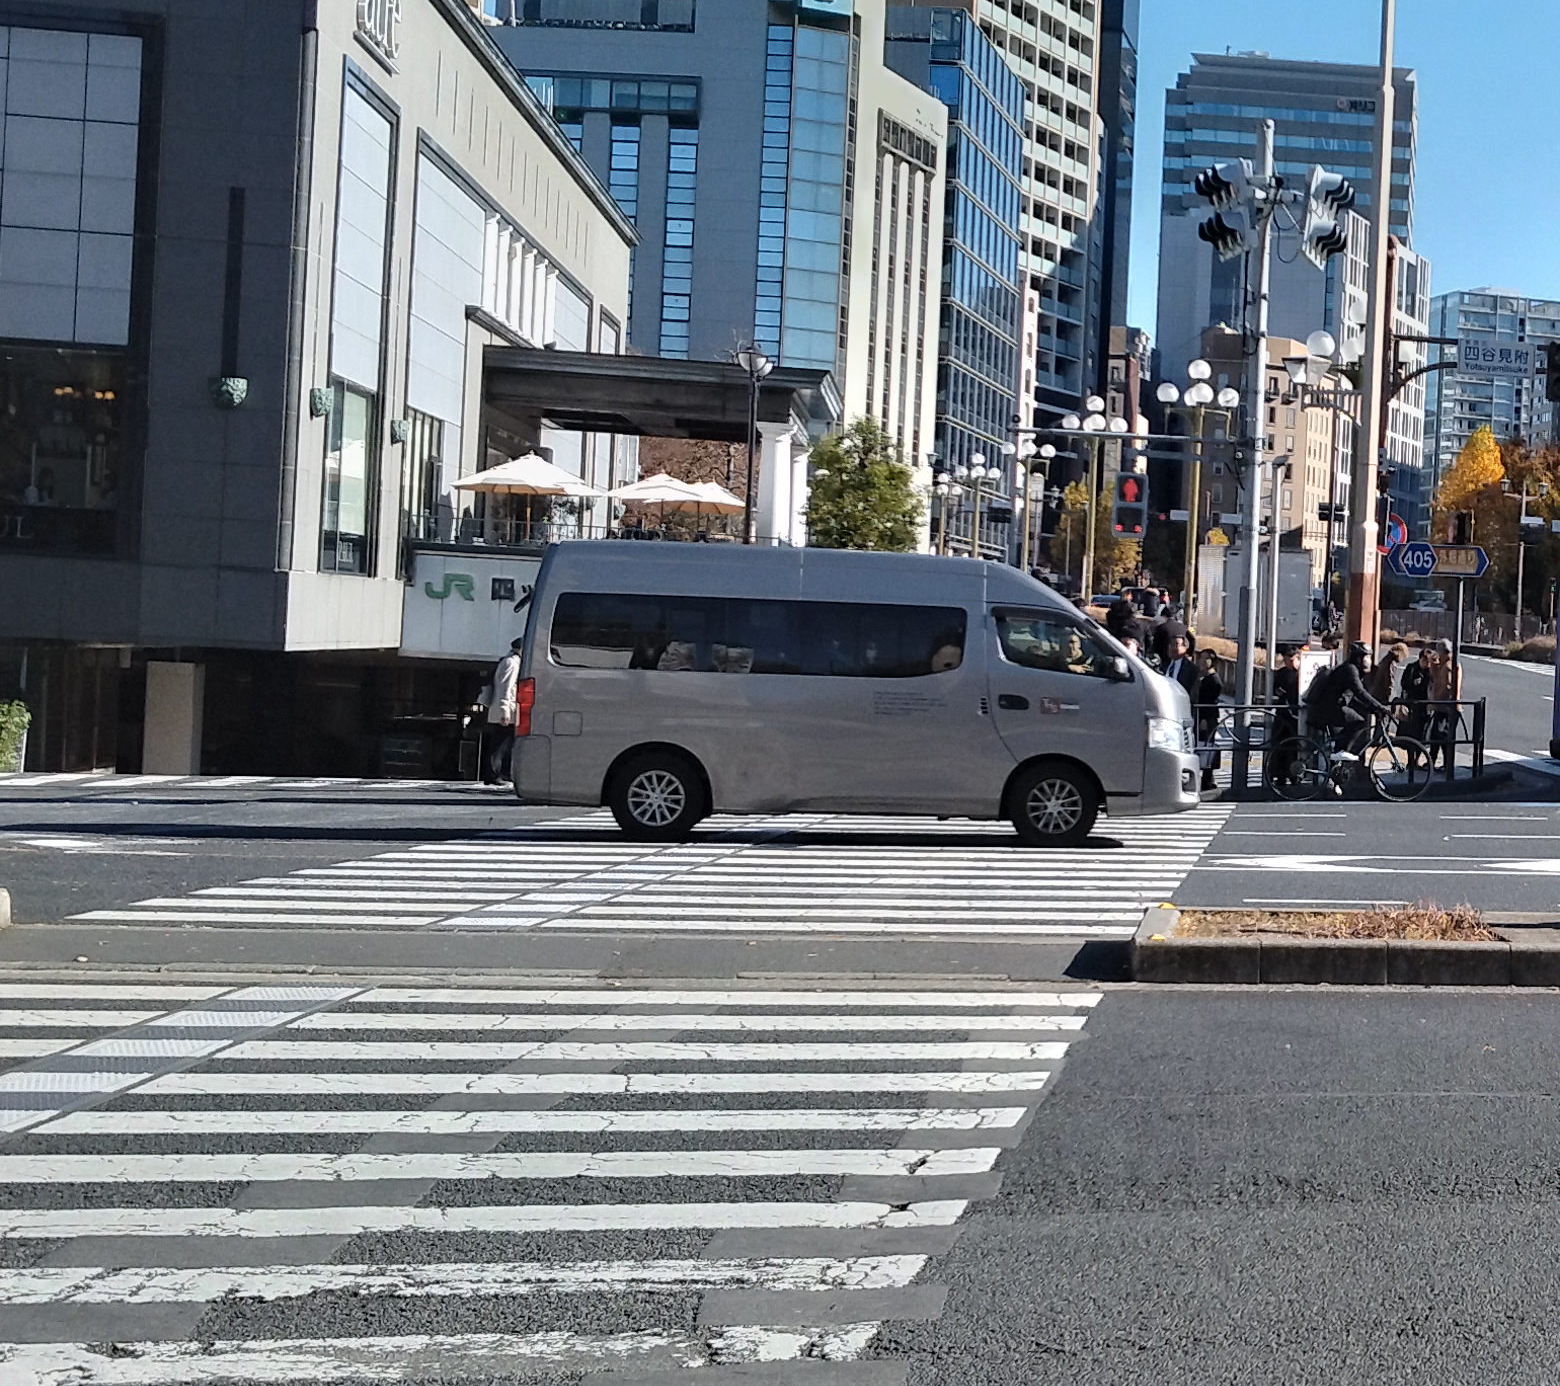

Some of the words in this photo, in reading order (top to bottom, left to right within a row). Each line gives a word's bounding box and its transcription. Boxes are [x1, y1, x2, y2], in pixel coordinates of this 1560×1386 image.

[1464, 346, 1529, 364] 四谷見附
[1403, 550, 1433, 569] 405
[425, 573, 475, 601] JR
